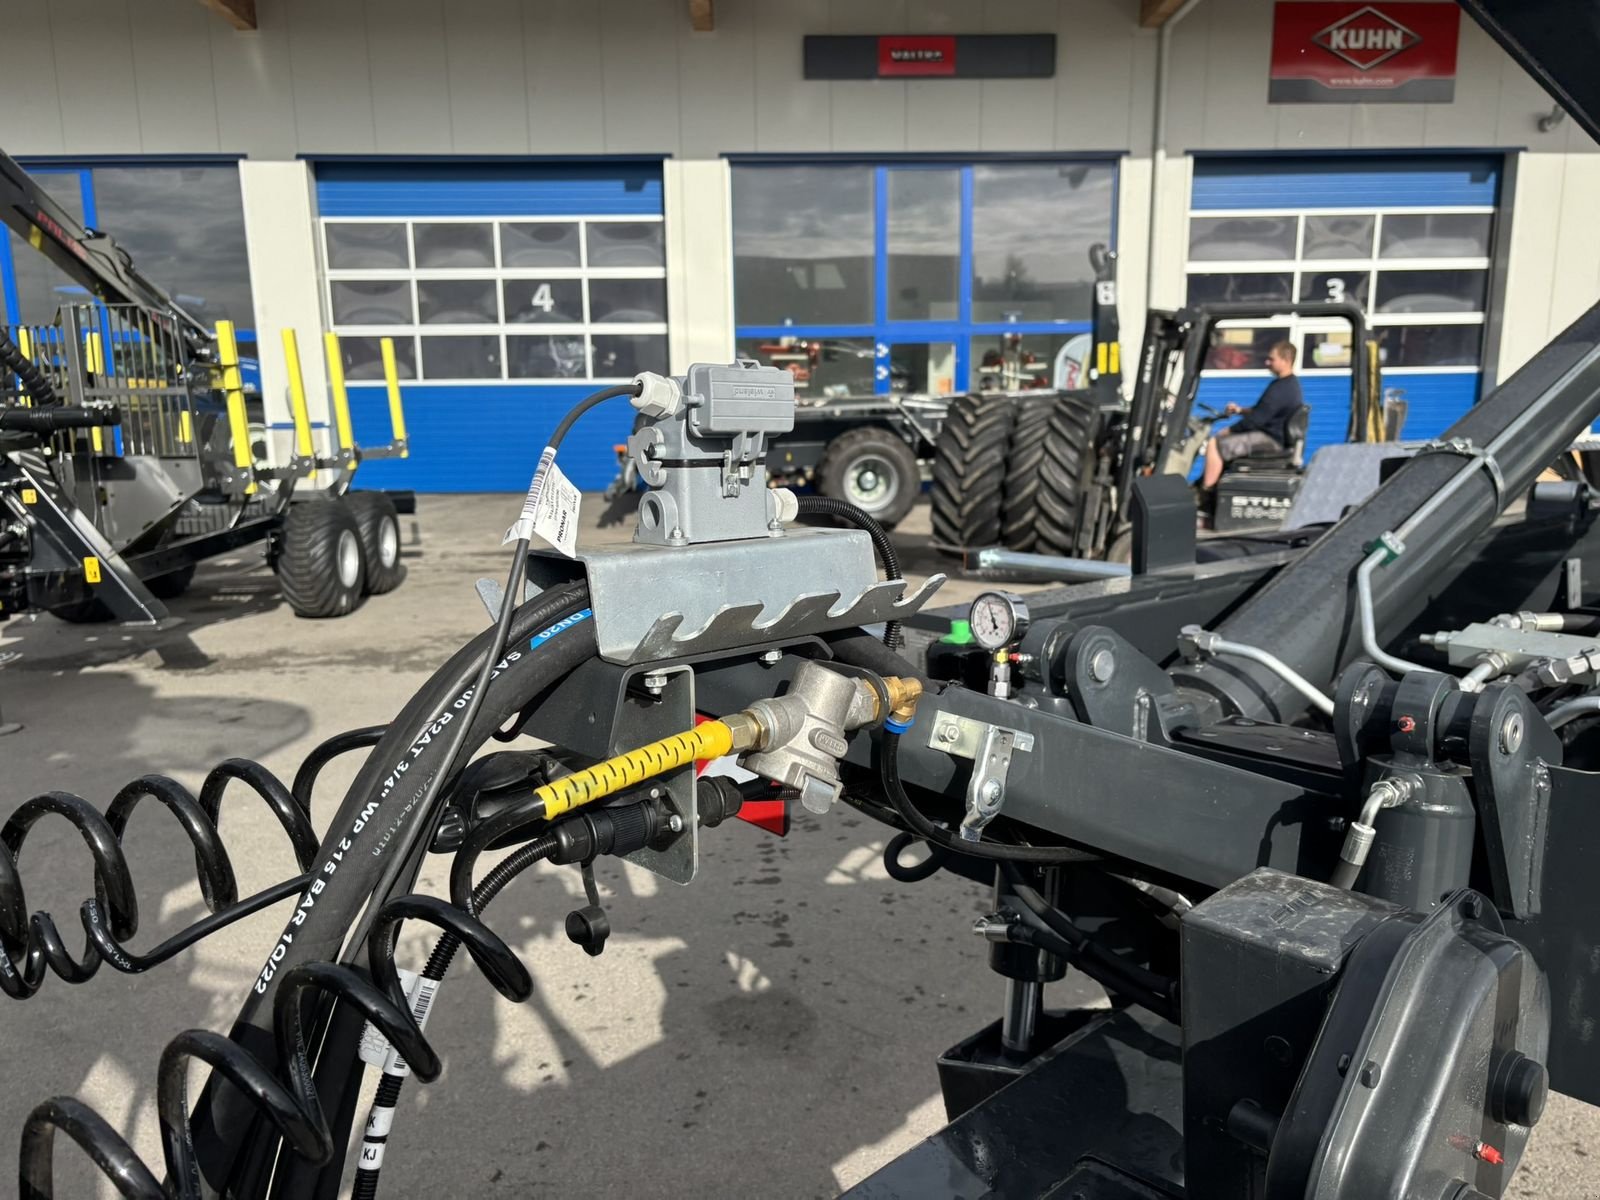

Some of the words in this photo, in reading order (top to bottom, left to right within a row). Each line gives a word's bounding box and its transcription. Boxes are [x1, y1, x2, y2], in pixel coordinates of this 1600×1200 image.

[1330, 29, 1403, 50] KUHN
[1329, 76, 1394, 87] www.kuhn.com
[532, 283, 555, 312] 4
[1324, 277, 1345, 304] 3
[1231, 496, 1292, 508] STILL
[556, 509, 568, 543] PRONAR
[538, 612, 585, 639] DN20
[410, 711, 455, 758] R2AT
[380, 760, 410, 798] 3/4"
[352, 801, 380, 834] WP
[323, 837, 352, 876] 215
[291, 878, 327, 926] BAR
[254, 933, 293, 994] 1Q/22
[362, 1147, 377, 1161] KJ
